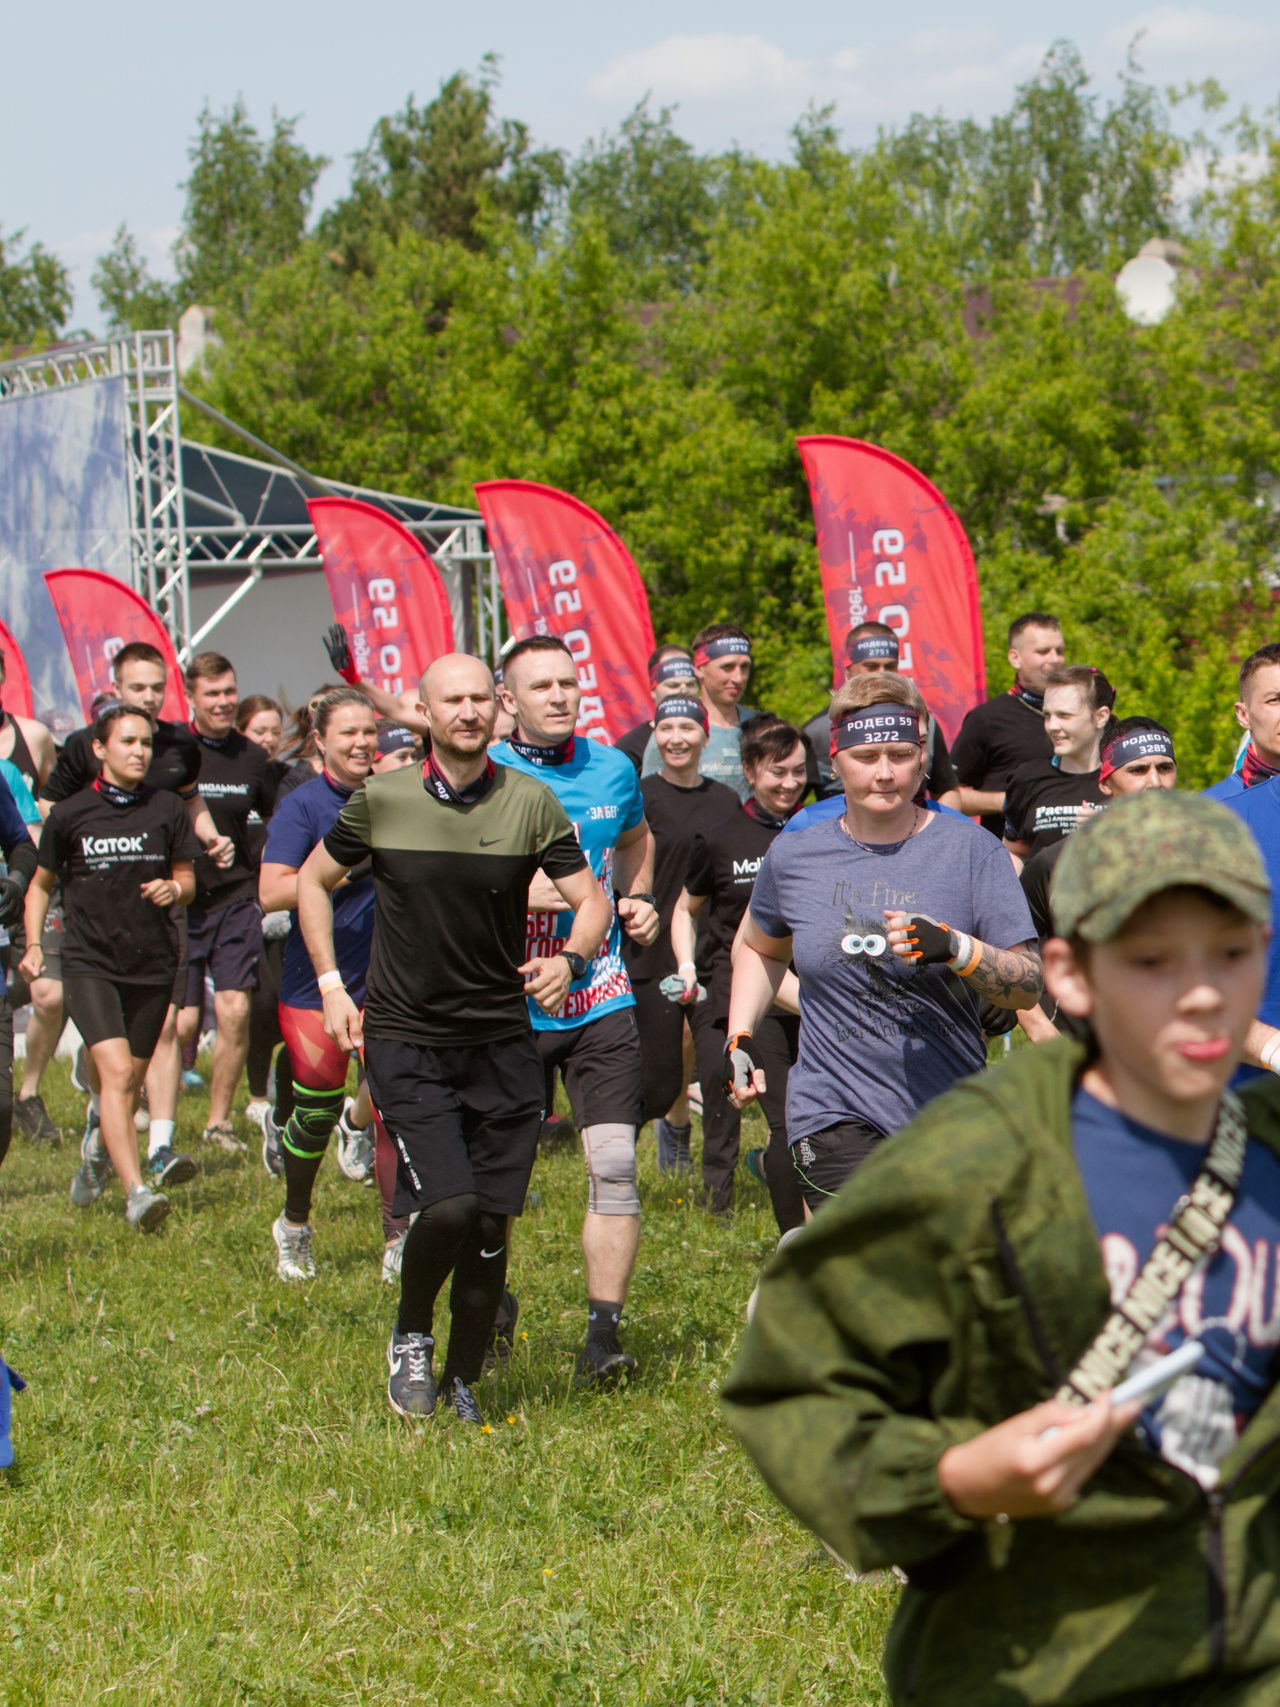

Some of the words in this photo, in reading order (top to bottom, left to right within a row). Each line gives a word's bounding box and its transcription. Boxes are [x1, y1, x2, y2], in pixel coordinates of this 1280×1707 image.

[857, 640, 889, 650] РОДЕО
[868, 648, 890, 656] 2751
[665, 705, 688, 714] 2011
[847, 716, 896, 732] РОДЕО
[899, 716, 912, 727] 59
[864, 730, 900, 743] 3272
[1122, 733, 1161, 748] РОДЕО
[1139, 743, 1167, 754] 3285
[82, 834, 143, 856] Каток
[831, 880, 863, 907] It's
[870, 879, 917, 908] Fine
